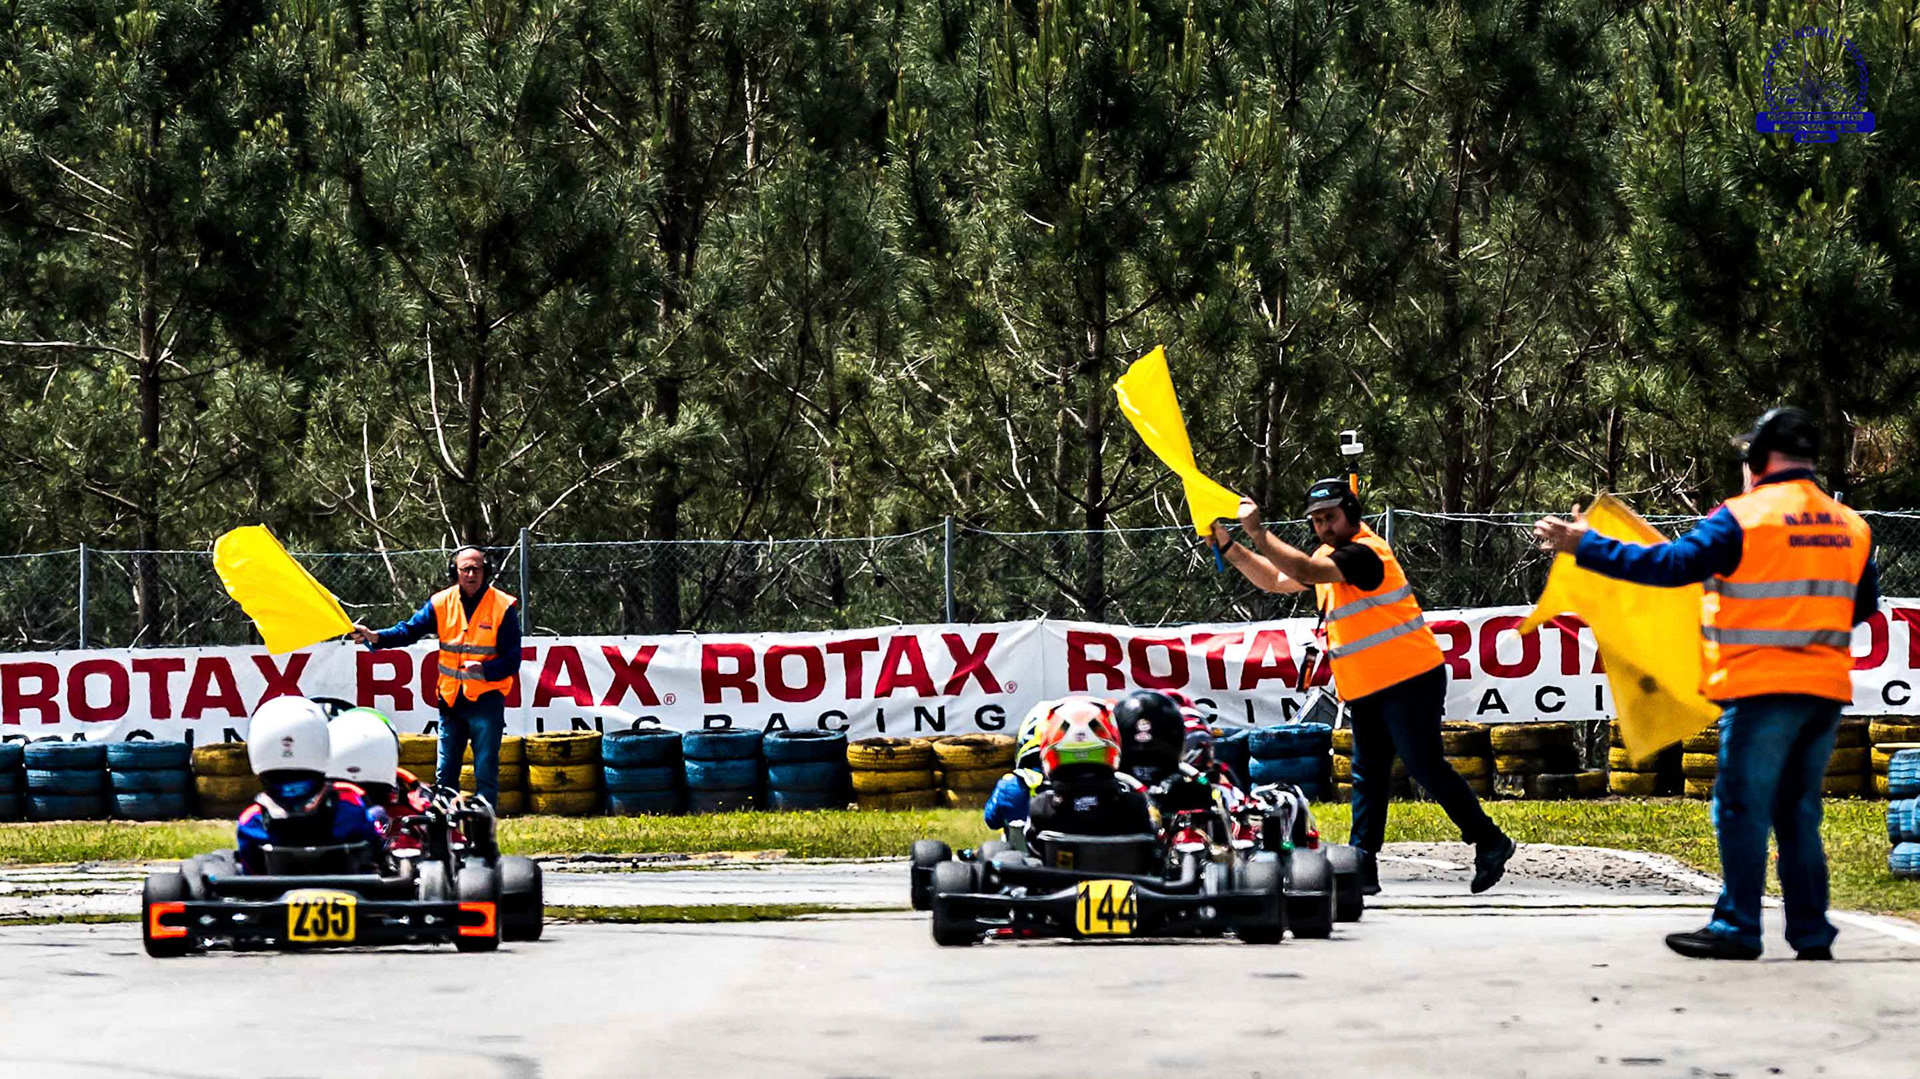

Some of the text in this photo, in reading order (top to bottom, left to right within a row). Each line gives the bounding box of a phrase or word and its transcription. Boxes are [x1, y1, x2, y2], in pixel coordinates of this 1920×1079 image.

[1067, 614, 1606, 692] ROTA ROT
[1, 653, 312, 725] ROTAX
[701, 633, 1003, 703] ROTAX
[703, 705, 1006, 734] RACING
[293, 897, 349, 937] 235
[1079, 884, 1137, 931] 144
